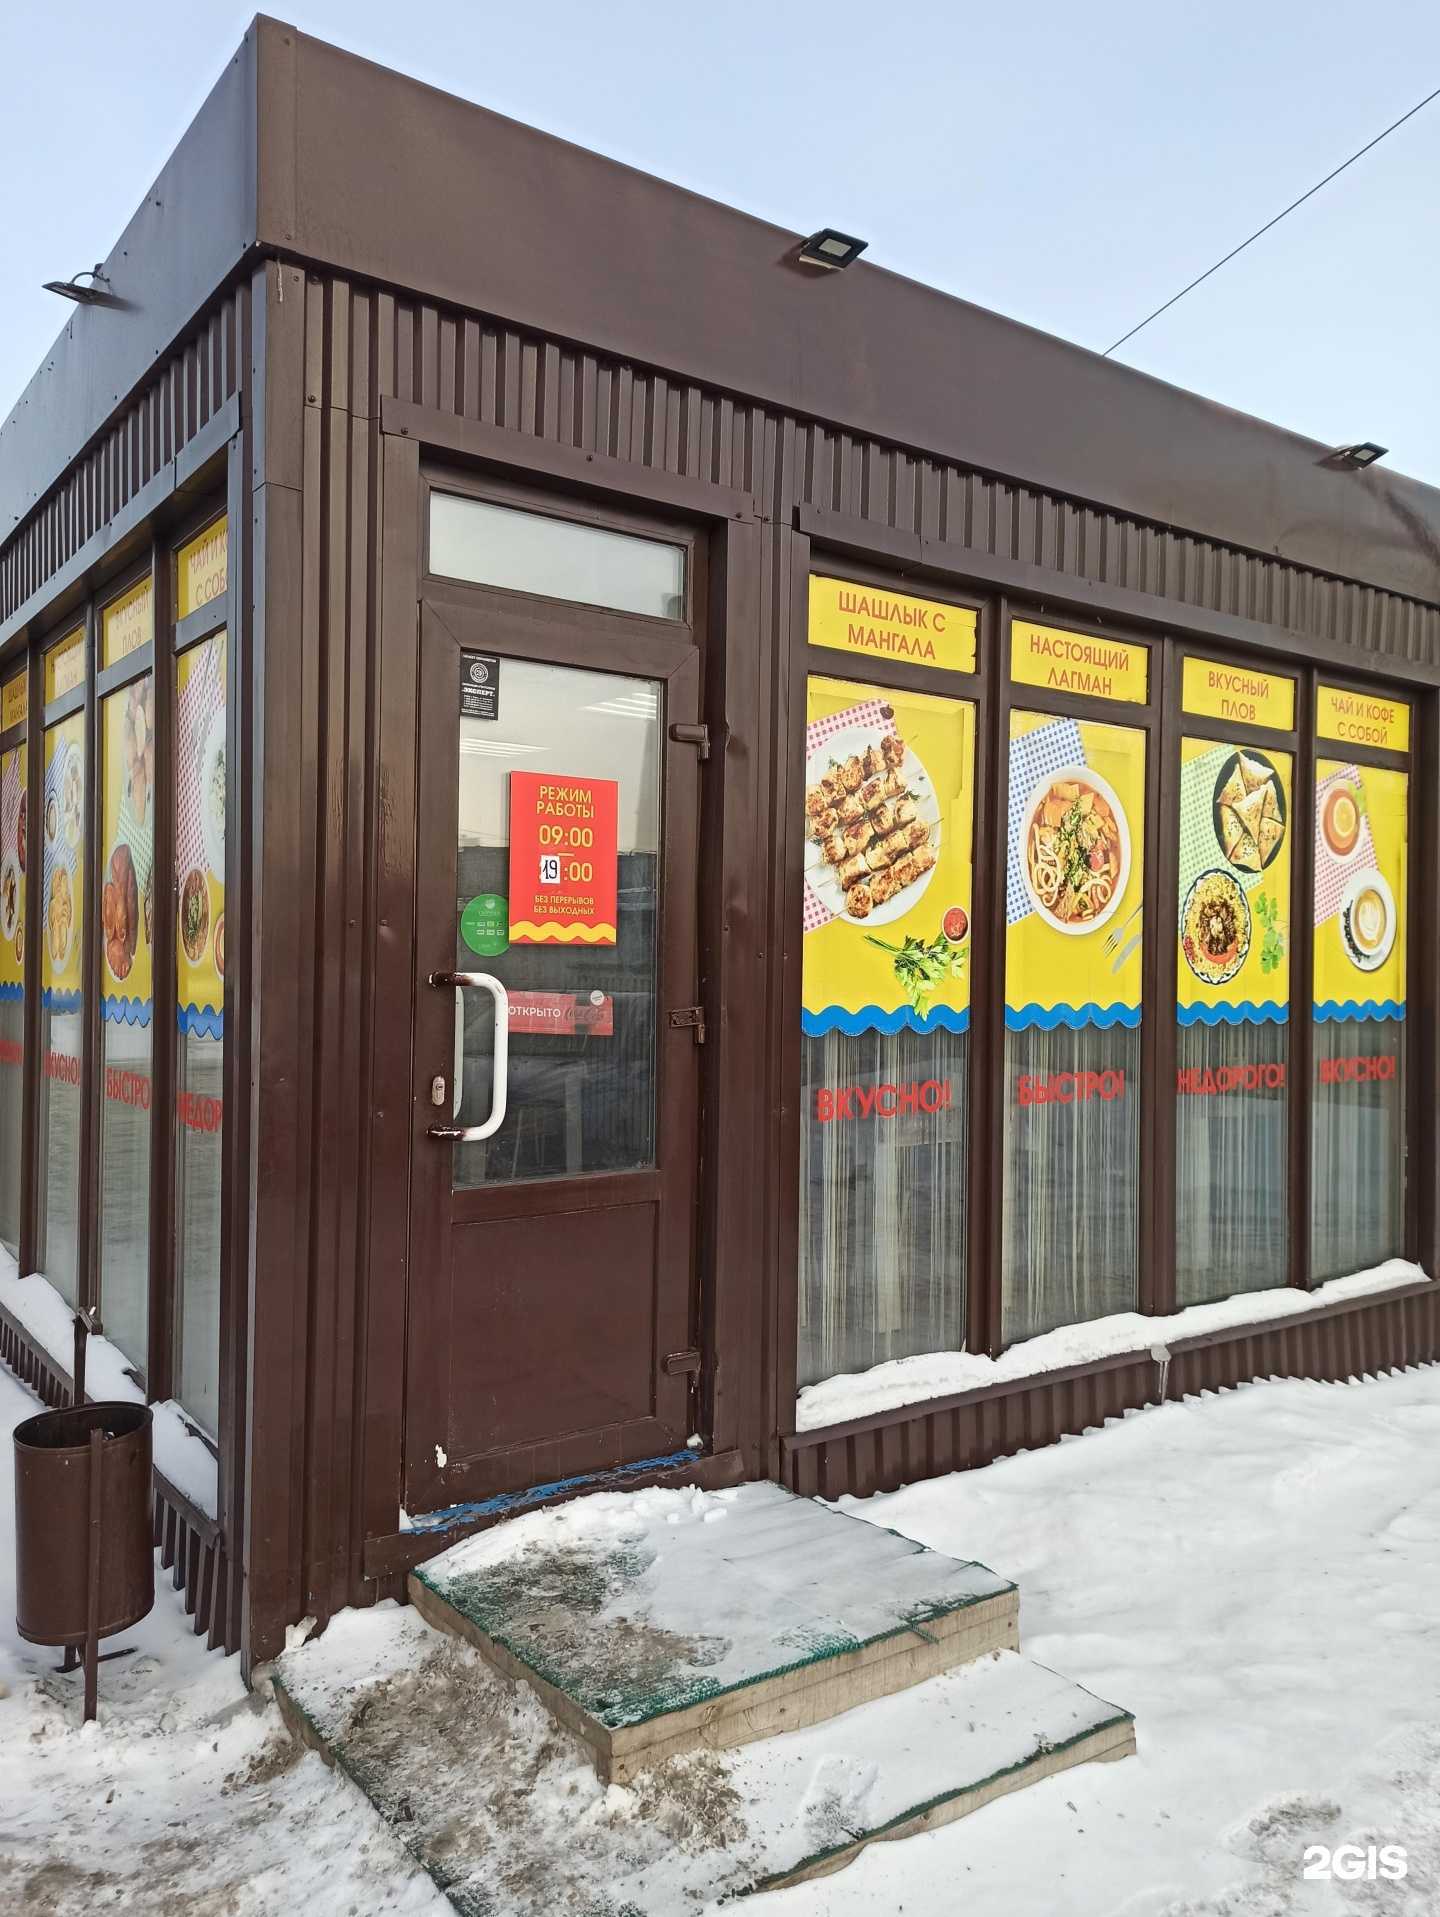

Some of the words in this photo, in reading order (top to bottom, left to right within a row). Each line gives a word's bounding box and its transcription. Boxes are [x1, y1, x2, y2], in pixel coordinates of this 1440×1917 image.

[838, 590, 928, 629] ШАШЛЫК
[933, 612, 946, 633] С
[848, 623, 936, 660] МАНГАЛА
[1030, 634, 1129, 671] НАСТОЯЩИЙ
[1047, 667, 1112, 696] ЛАГМАН
[1208, 671, 1269, 699] ВКУСНЫЙ
[1221, 700, 1256, 721] ПЛОВ
[1331, 696, 1354, 715] ЧАЙ
[1356, 702, 1364, 716] И
[1366, 704, 1395, 724] КОФЕ
[1337, 721, 1346, 736] С
[1348, 723, 1388, 744] СОБОЙ
[539, 785, 592, 803] РЕЖИМ
[536, 800, 594, 819] РАБОТЫ
[539, 824, 593, 848] 09:00
[533, 905, 547, 913] БЕЗ
[549, 905, 594, 915] ВЫХОДНЫХ
[535, 895, 548, 903] БЕЗ
[550, 895, 594, 905] ПЕРЕРЫВОВ
[508, 1006, 561, 1018] ОТКРЫТО
[1176, 1063, 1286, 1095] НЕДОРОГО!
[1319, 1055, 1396, 1085] ВКУСНО!
[816, 1079, 953, 1122] ВКУСНО!
[1016, 1069, 1125, 1106] БЫСТРО!
